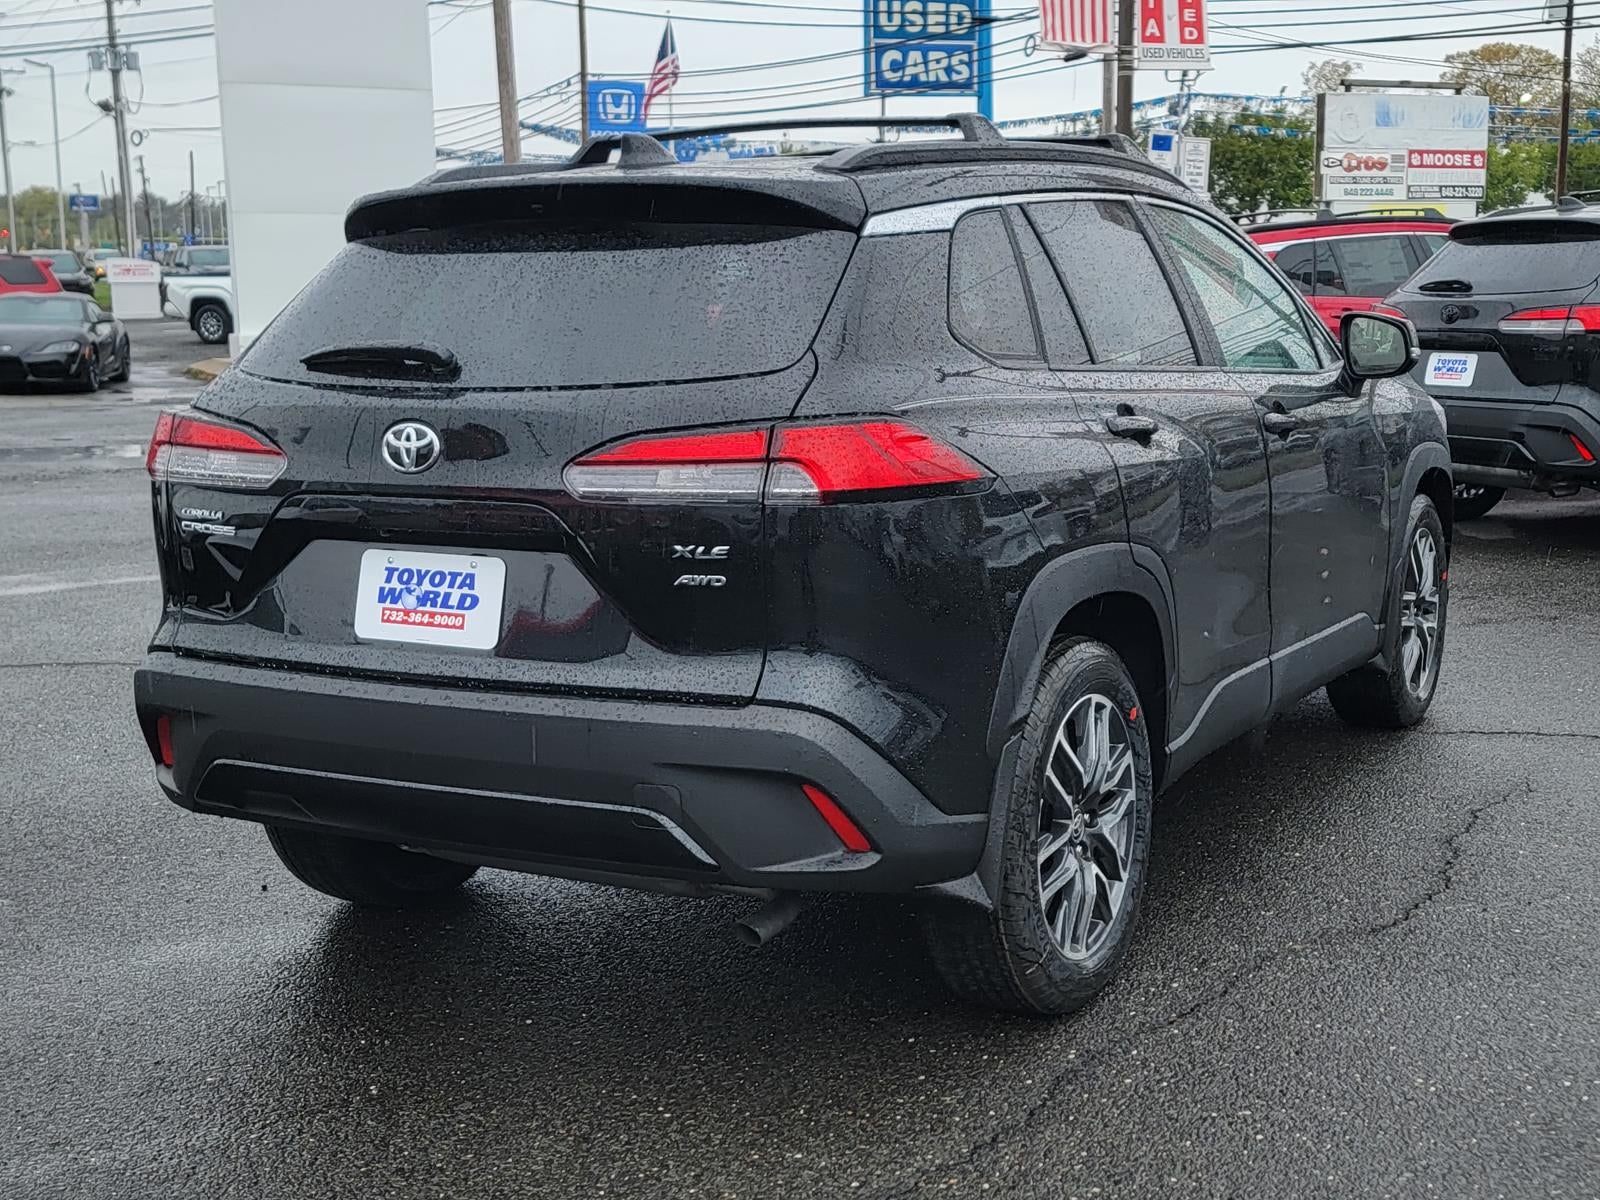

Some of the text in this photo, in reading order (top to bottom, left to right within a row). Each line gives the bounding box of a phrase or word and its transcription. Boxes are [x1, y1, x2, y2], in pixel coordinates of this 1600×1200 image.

[879, 0, 972, 34] USED
[1143, 48, 1205, 59] USED VEHICLES
[881, 49, 970, 82] CARS
[1423, 154, 1471, 167] MOOSE
[1360, 188, 1374, 196] 222
[182, 508, 223, 520] COROLLA
[182, 521, 235, 535] CROSS
[672, 545, 730, 559] XLE
[384, 566, 476, 590] TOYOTA
[673, 575, 727, 586] AWD
[377, 586, 480, 611] WORLD
[383, 610, 463, 626] 732-364-9000
